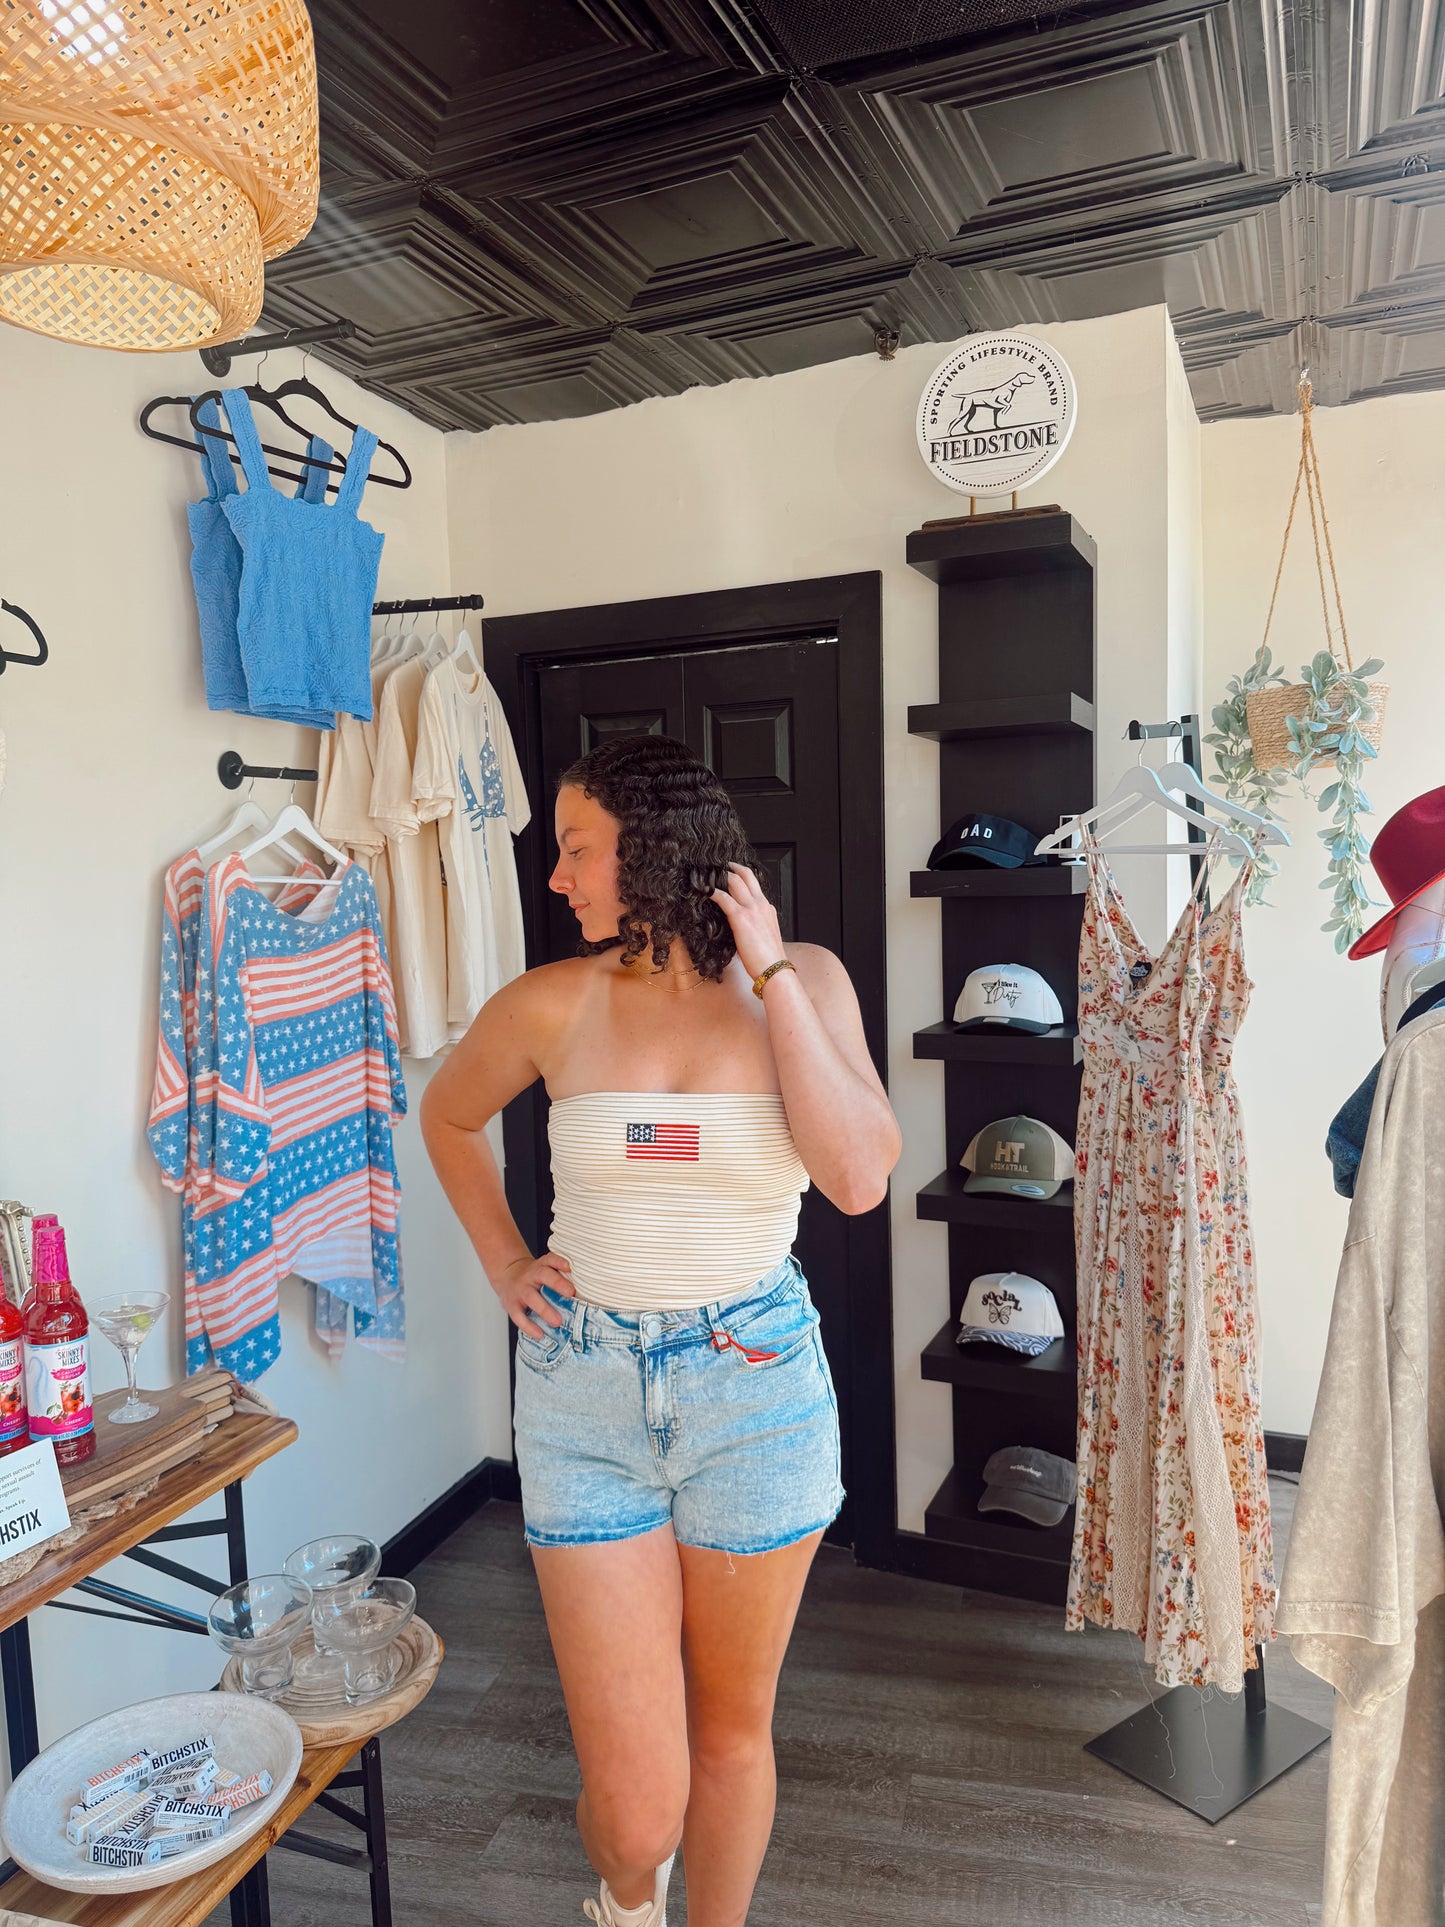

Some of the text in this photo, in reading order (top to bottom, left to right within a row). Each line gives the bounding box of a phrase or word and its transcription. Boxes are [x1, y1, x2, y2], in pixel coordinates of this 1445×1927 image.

[930, 346, 1058, 425] SPORTING LIFESTYLE BRAND
[929, 423, 1059, 464] FIELDSTONE
[960, 823, 993, 840] DAD
[994, 1141, 1025, 1163] HT
[58, 1346, 79, 1360] SKINNY
[62, 1354, 80, 1367] MIXES
[0, 1508, 42, 1545] HSTIX
[151, 1738, 209, 1770] BITCHSTIX
[118, 1794, 169, 1835] BITCHSTIX
[165, 1800, 225, 1818] BITCHSTIX
[95, 1835, 153, 1851] BITCHSTIX
[92, 1845, 144, 1867] BITCHSTIX
